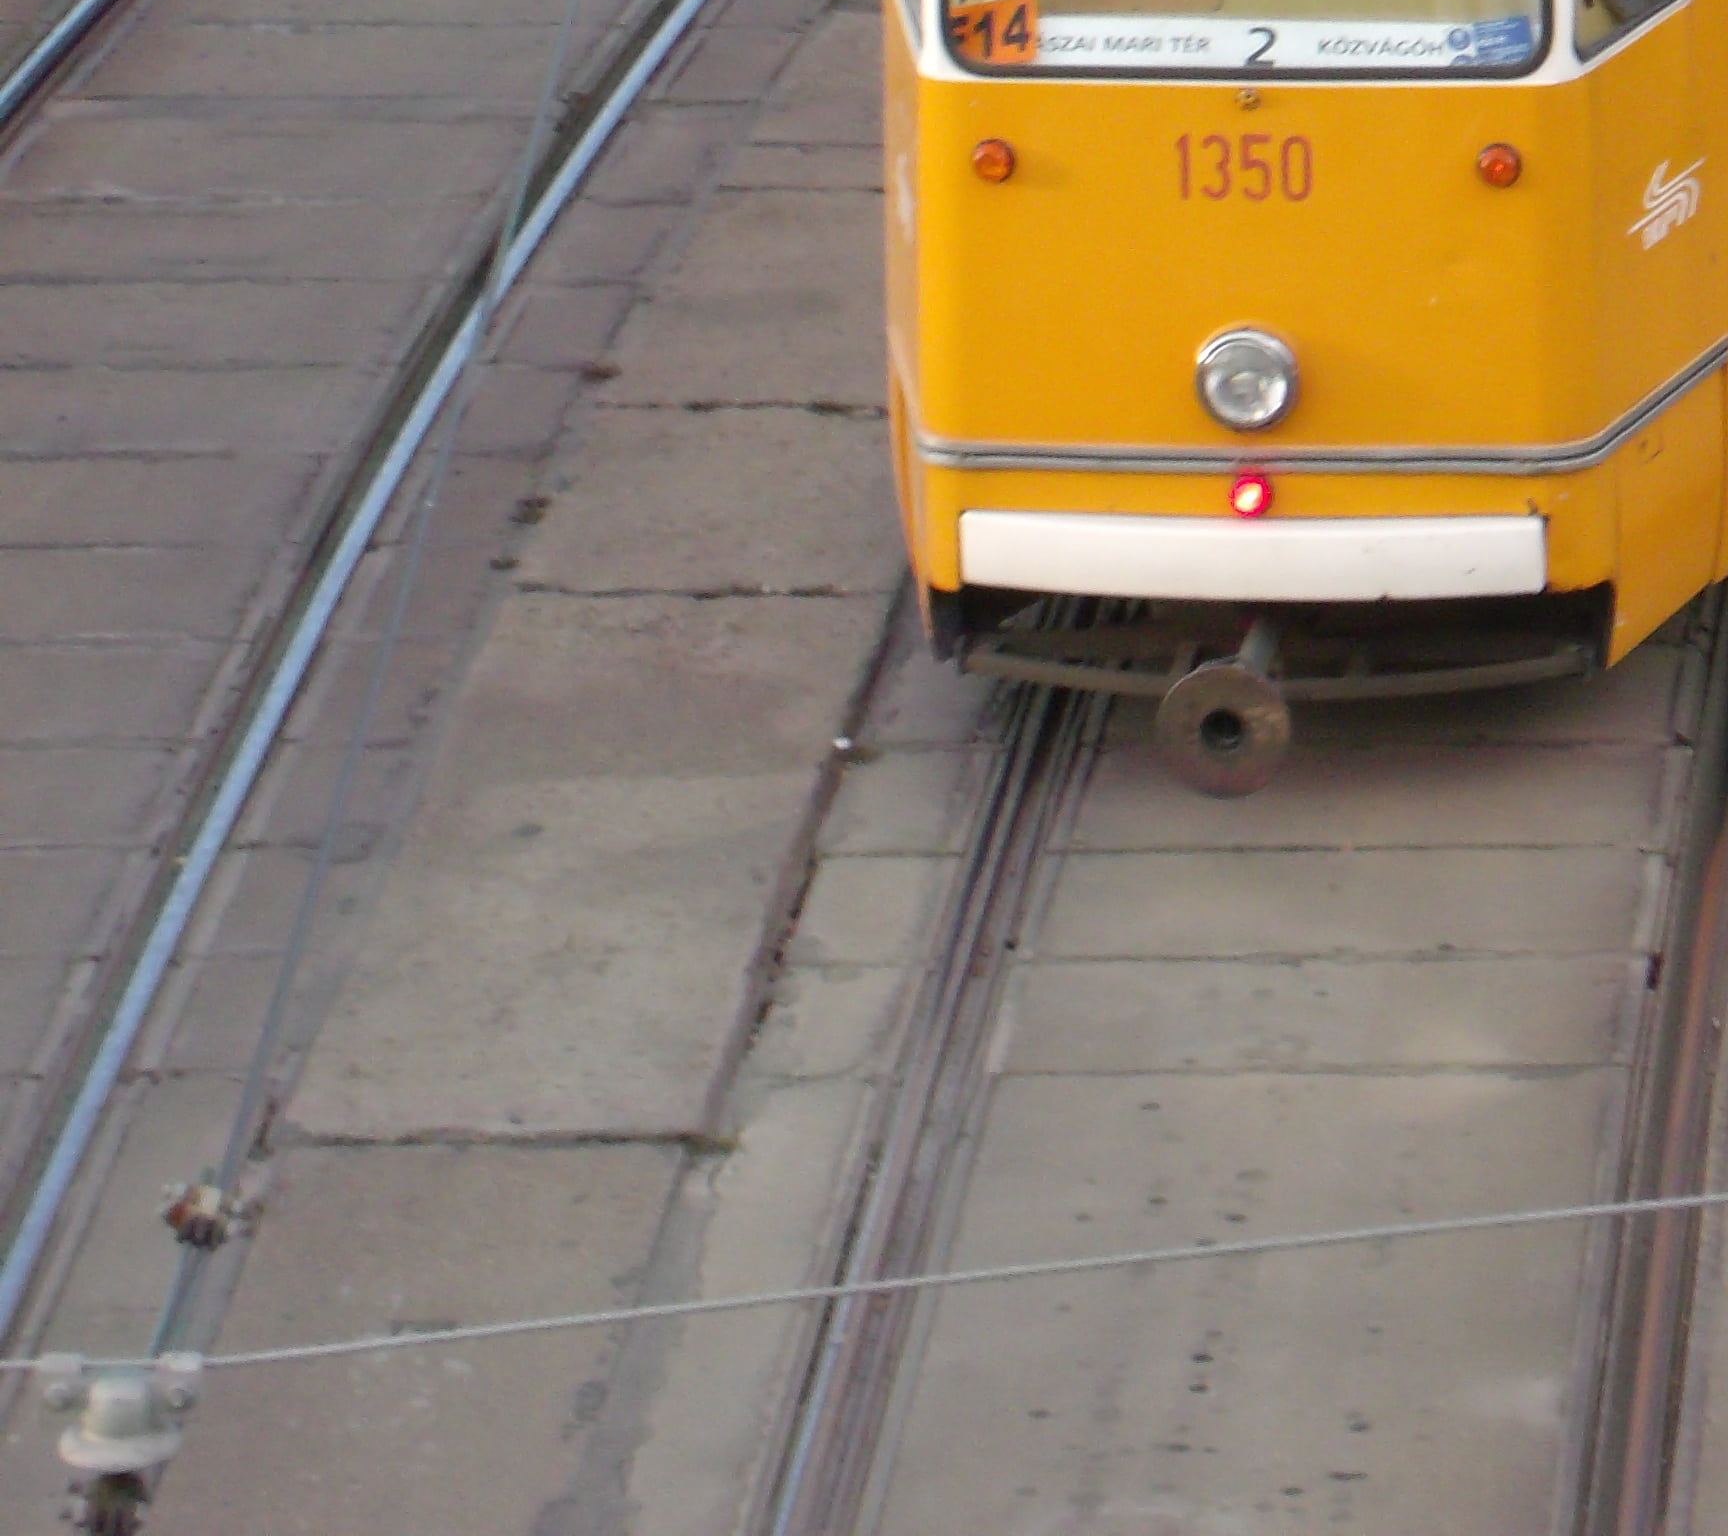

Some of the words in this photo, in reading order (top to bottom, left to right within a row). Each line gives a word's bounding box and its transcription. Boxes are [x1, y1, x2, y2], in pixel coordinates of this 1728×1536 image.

[1103, 34, 1162, 53] MARI
[1171, 32, 1211, 53] TÉR
[1245, 26, 1278, 66] 2
[1317, 36, 1444, 57] KÖZVÁGÓH
[1174, 132, 1314, 202] 1350
